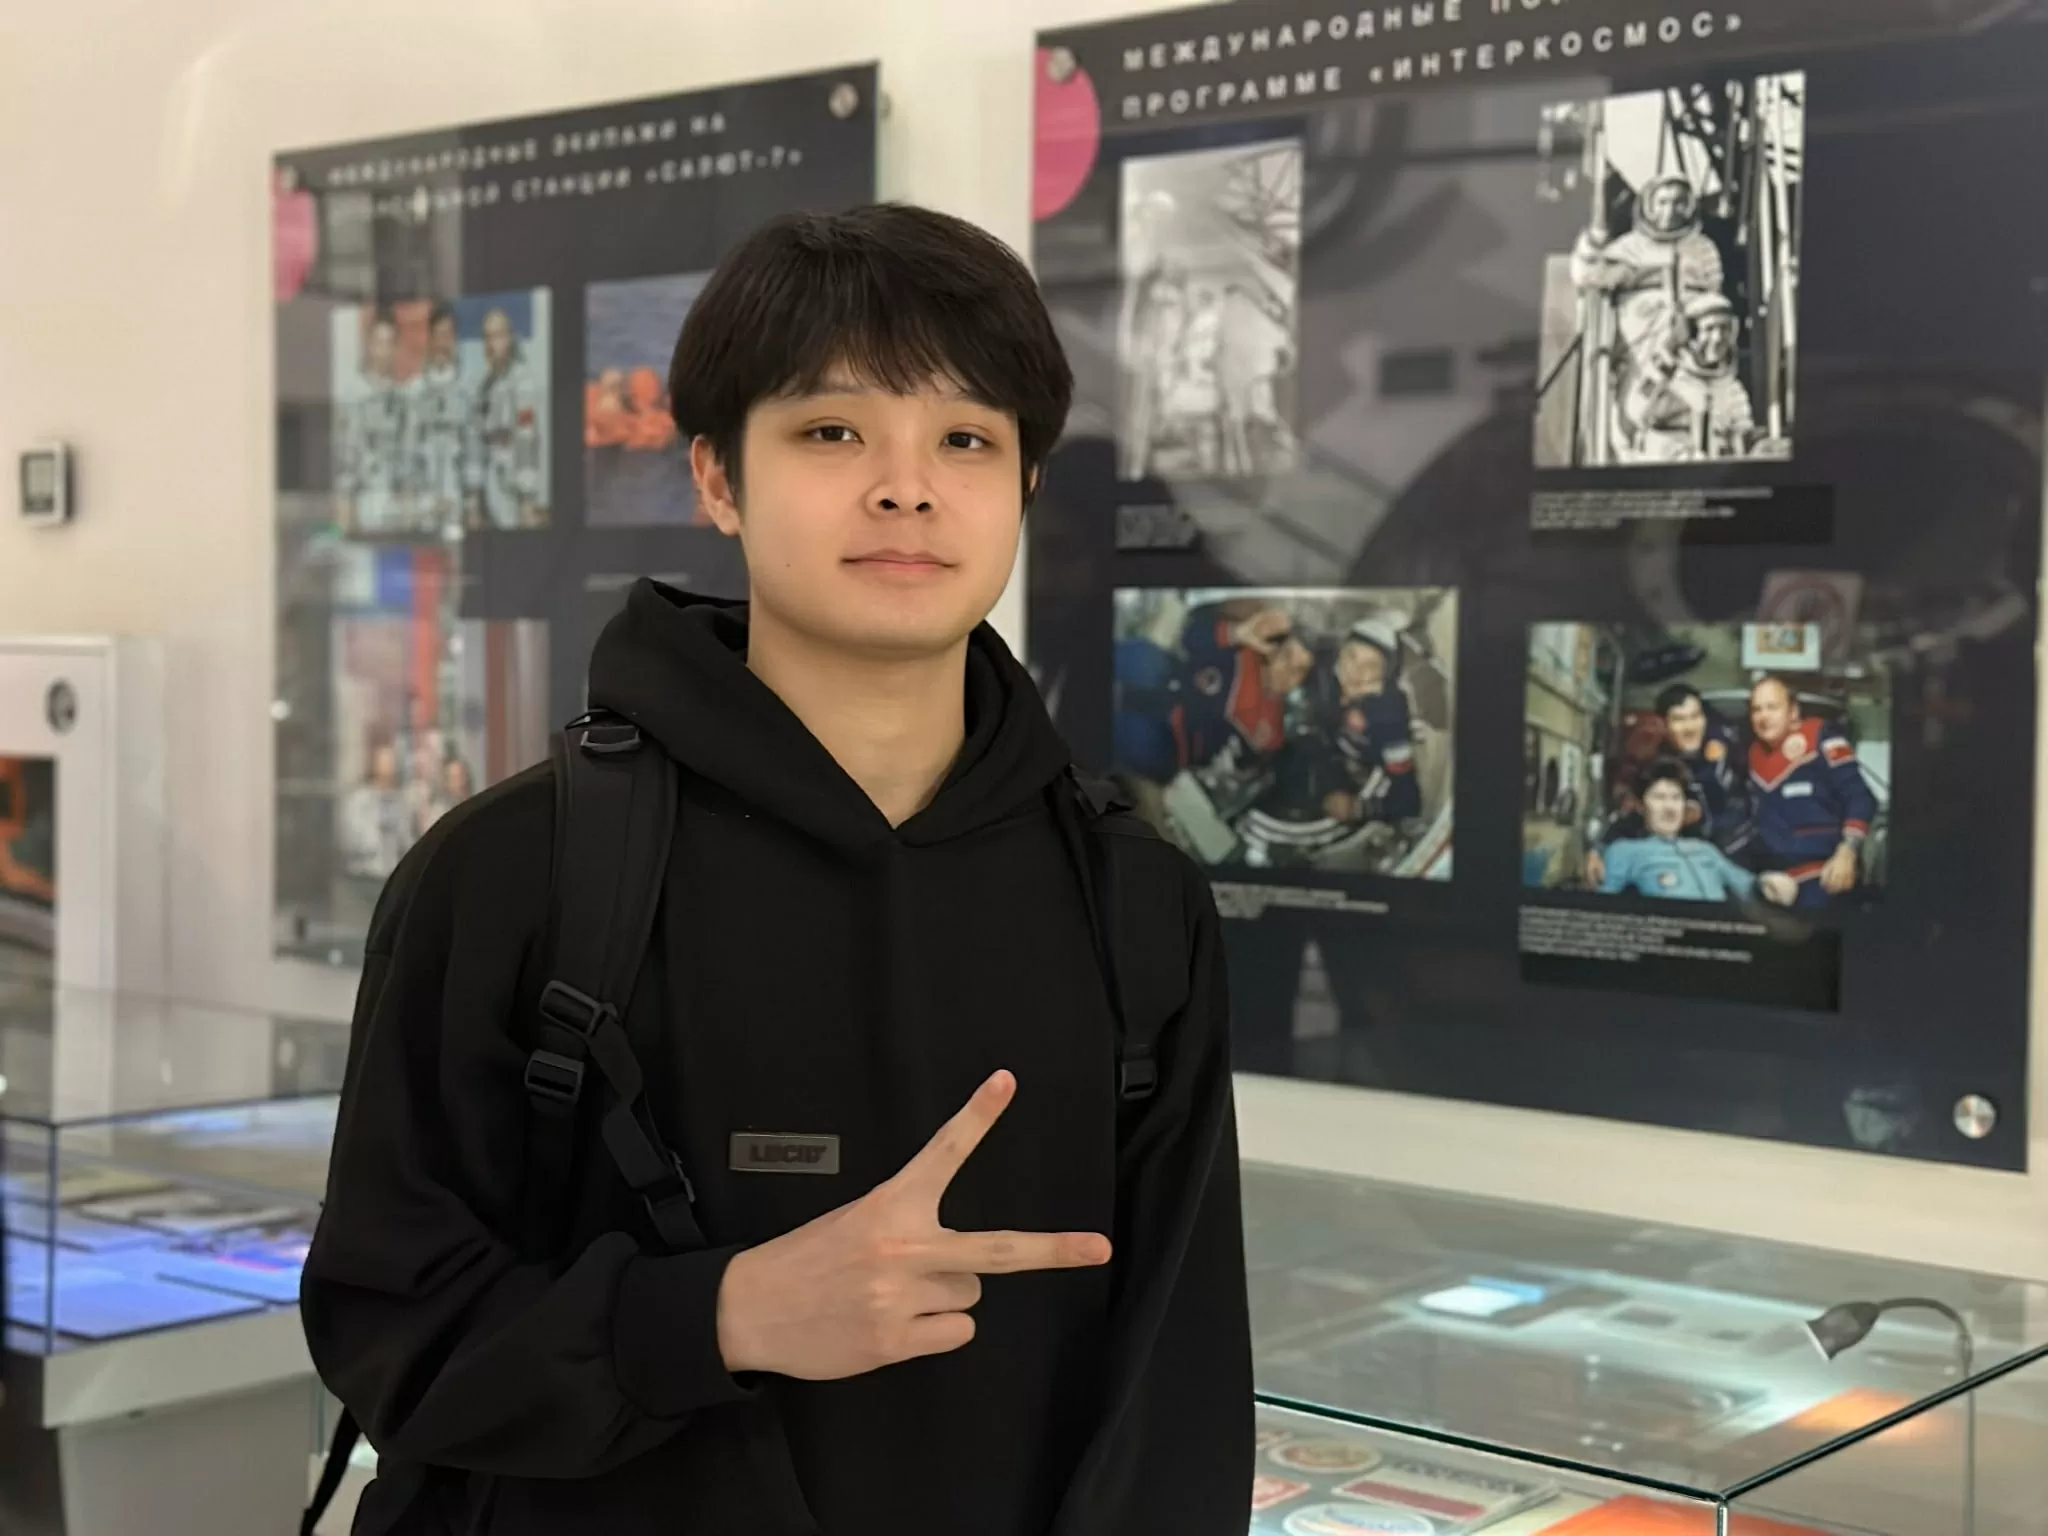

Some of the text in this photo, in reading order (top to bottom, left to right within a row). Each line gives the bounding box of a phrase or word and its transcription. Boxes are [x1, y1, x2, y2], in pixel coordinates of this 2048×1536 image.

[1122, 0, 1462, 72] МЕЖДУНАРОДНЫЕ
[1122, 11, 1742, 120] ПРОГРАММЕ «ИНТЕРКОСМОС»
